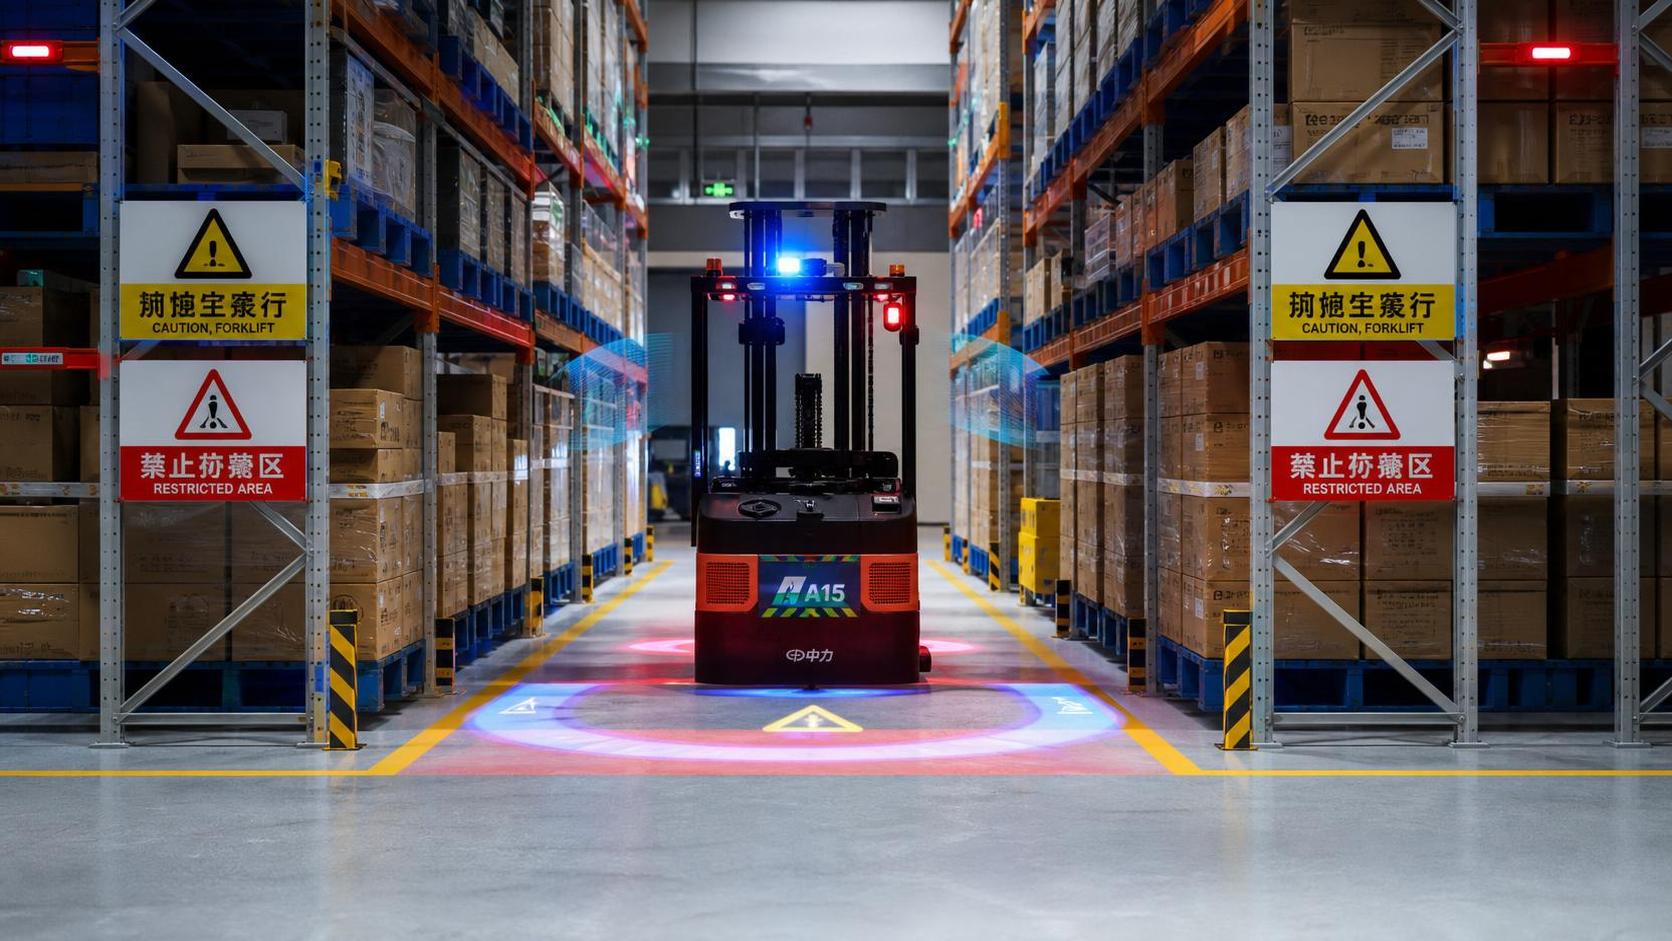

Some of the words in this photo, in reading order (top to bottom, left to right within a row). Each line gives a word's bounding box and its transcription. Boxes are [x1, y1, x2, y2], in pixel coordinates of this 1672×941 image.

[152, 322, 212, 335] CAUTION,
[215, 322, 275, 334] FORKLIFT
[1302, 322, 1362, 335] CAUTION,
[1365, 322, 1424, 334] FORKLIFT
[153, 483, 234, 494] RESTRICTED
[237, 483, 273, 494] AREA
[1303, 483, 1383, 494] RESTRICTED
[1386, 483, 1422, 494] AREA
[804, 584, 846, 602] A15
[805, 648, 834, 662] 中力
